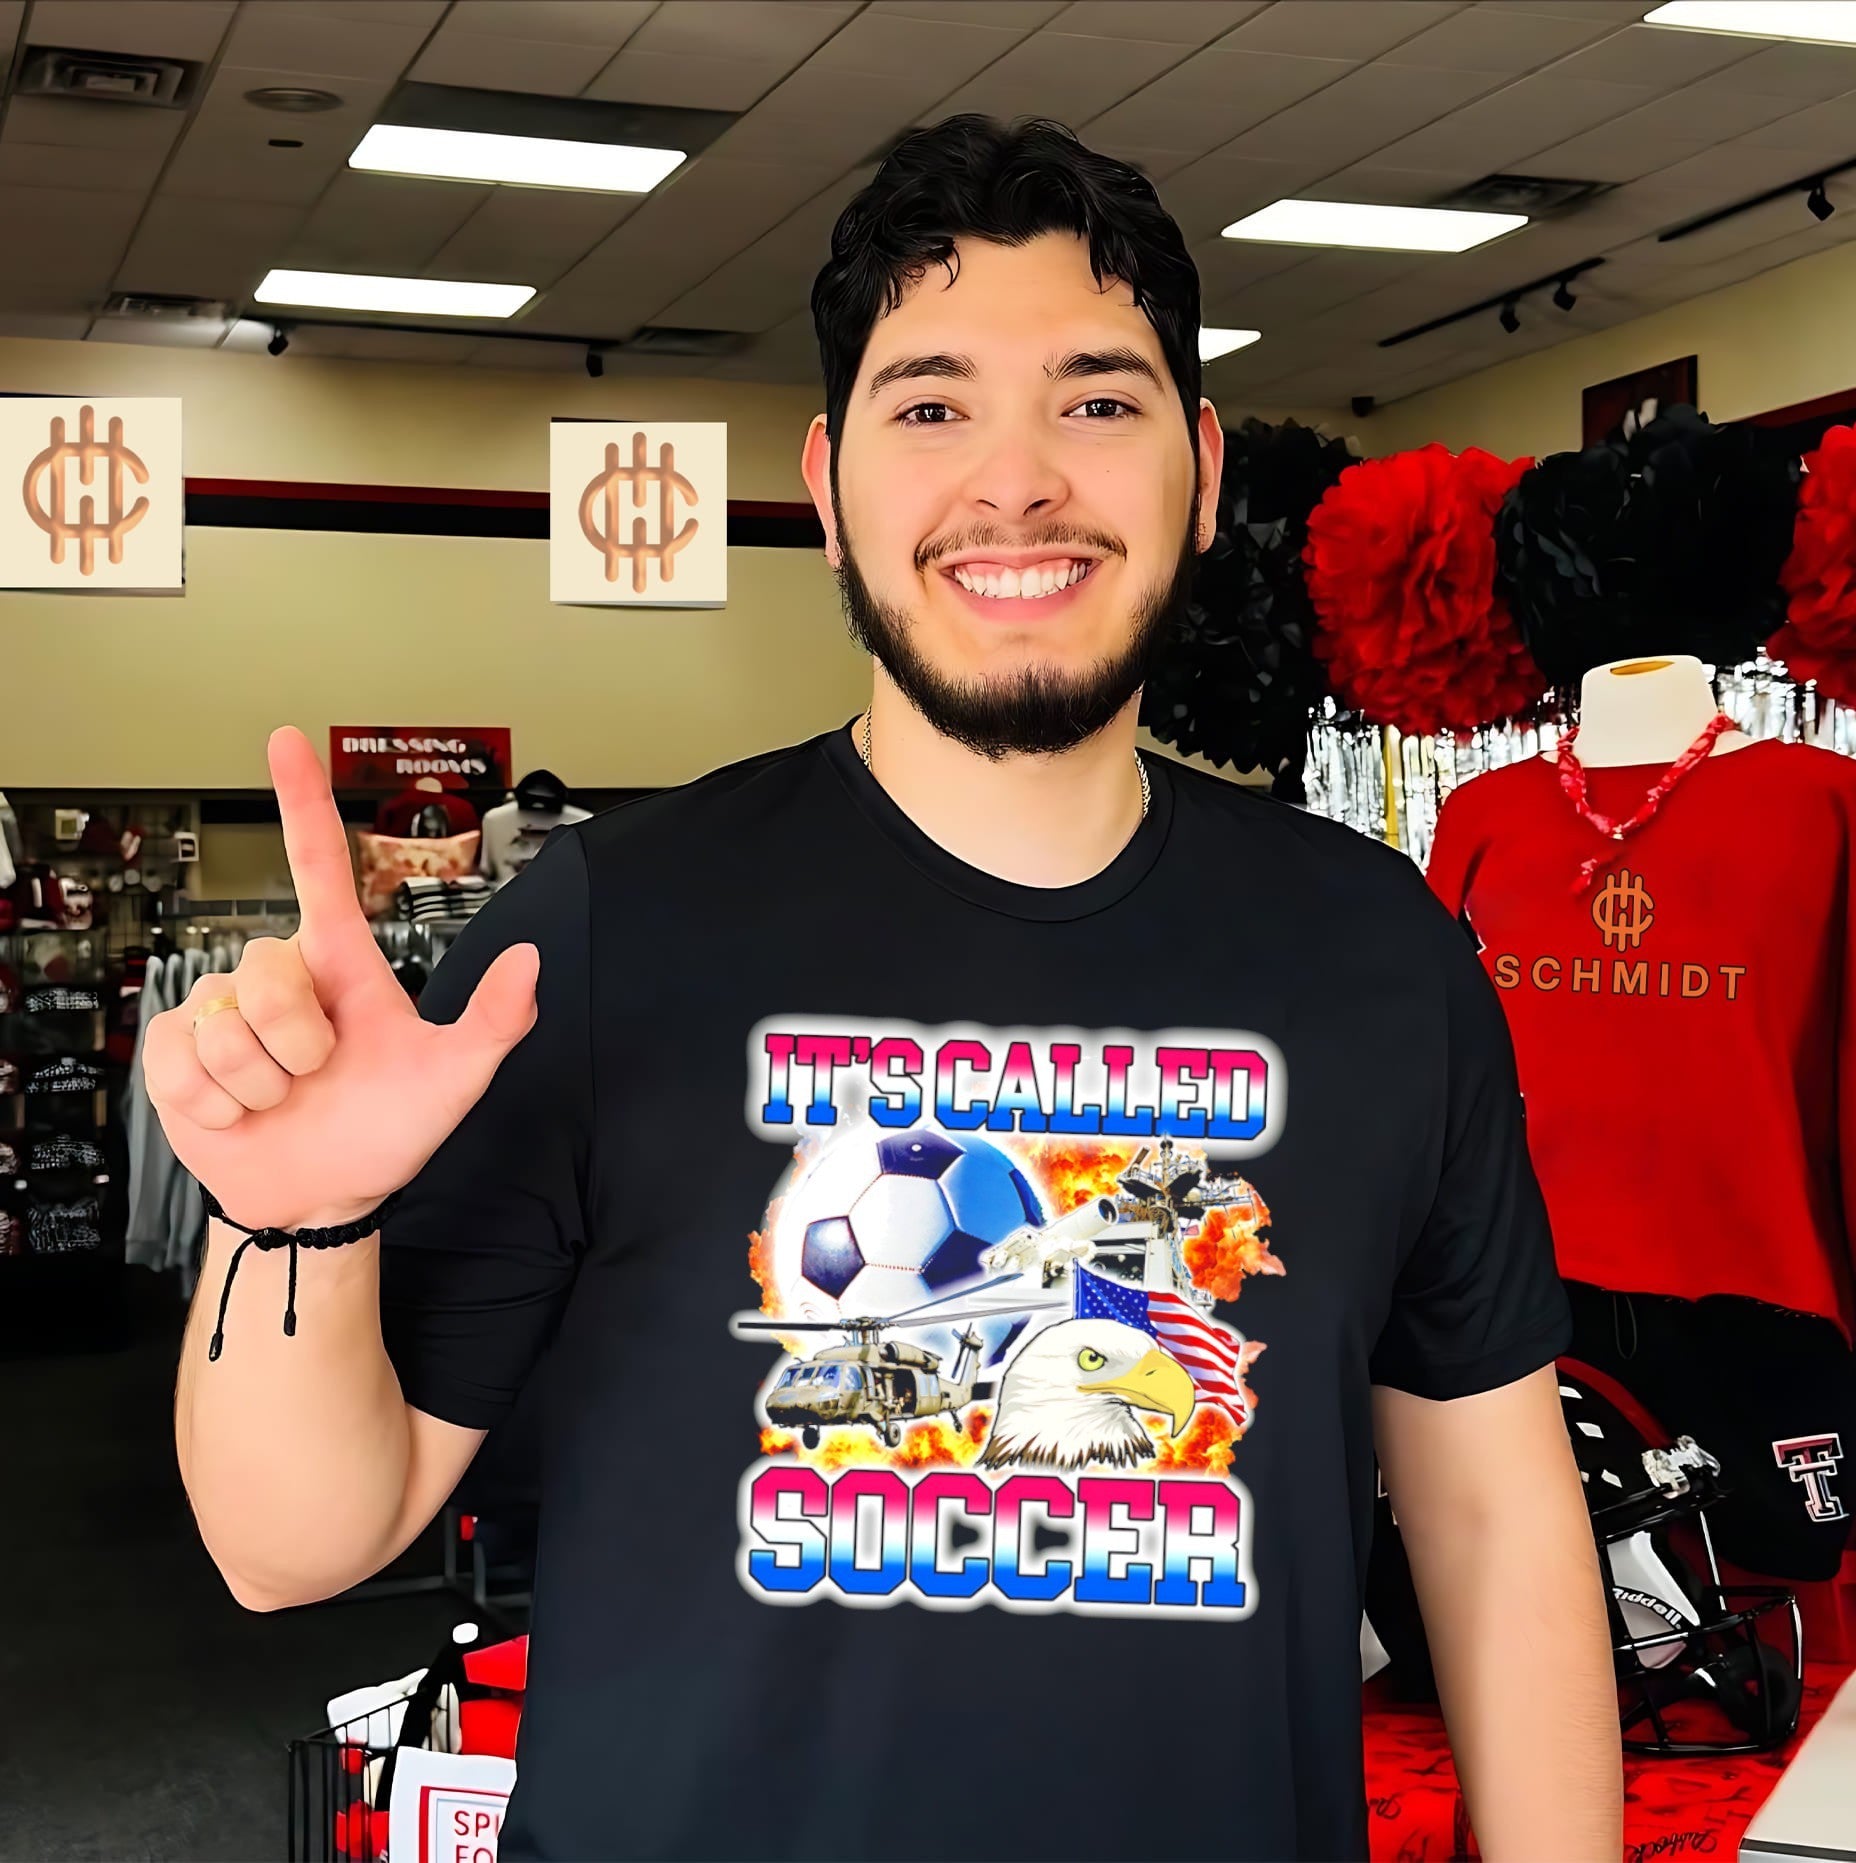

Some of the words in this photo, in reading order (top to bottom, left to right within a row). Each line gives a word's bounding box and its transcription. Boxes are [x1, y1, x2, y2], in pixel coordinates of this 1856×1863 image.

[396, 758, 487, 775] ROOMS
[1494, 954, 1746, 1000] SCHMIDT
[763, 1033, 924, 1128] IT'S
[934, 1039, 1268, 1140] CALLED
[748, 1466, 1246, 1608] SOCCER
